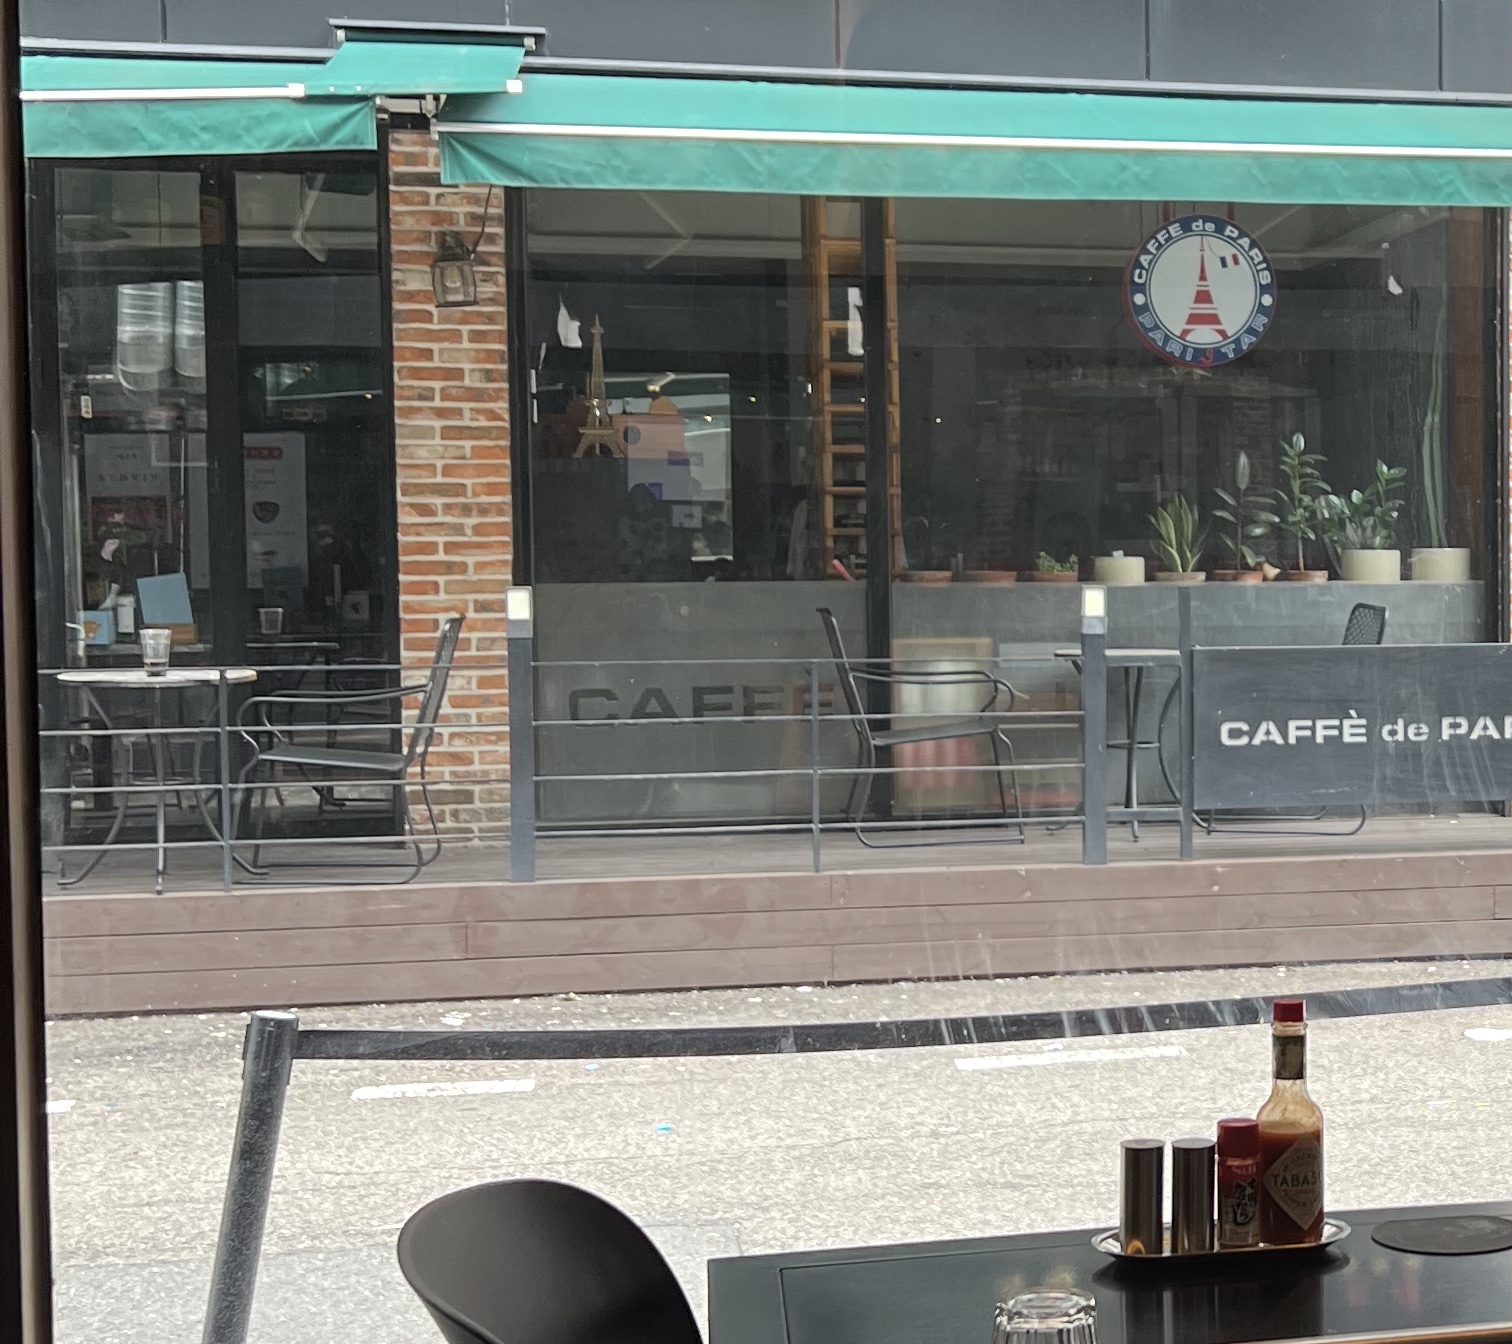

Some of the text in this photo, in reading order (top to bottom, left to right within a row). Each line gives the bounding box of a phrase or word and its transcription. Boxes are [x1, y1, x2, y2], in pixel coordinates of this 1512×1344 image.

[1191, 218, 1216, 232] de
[1224, 224, 1272, 285] PARIS
[1219, 709, 1368, 746] CAFFÈ
[1380, 717, 1430, 743] de
